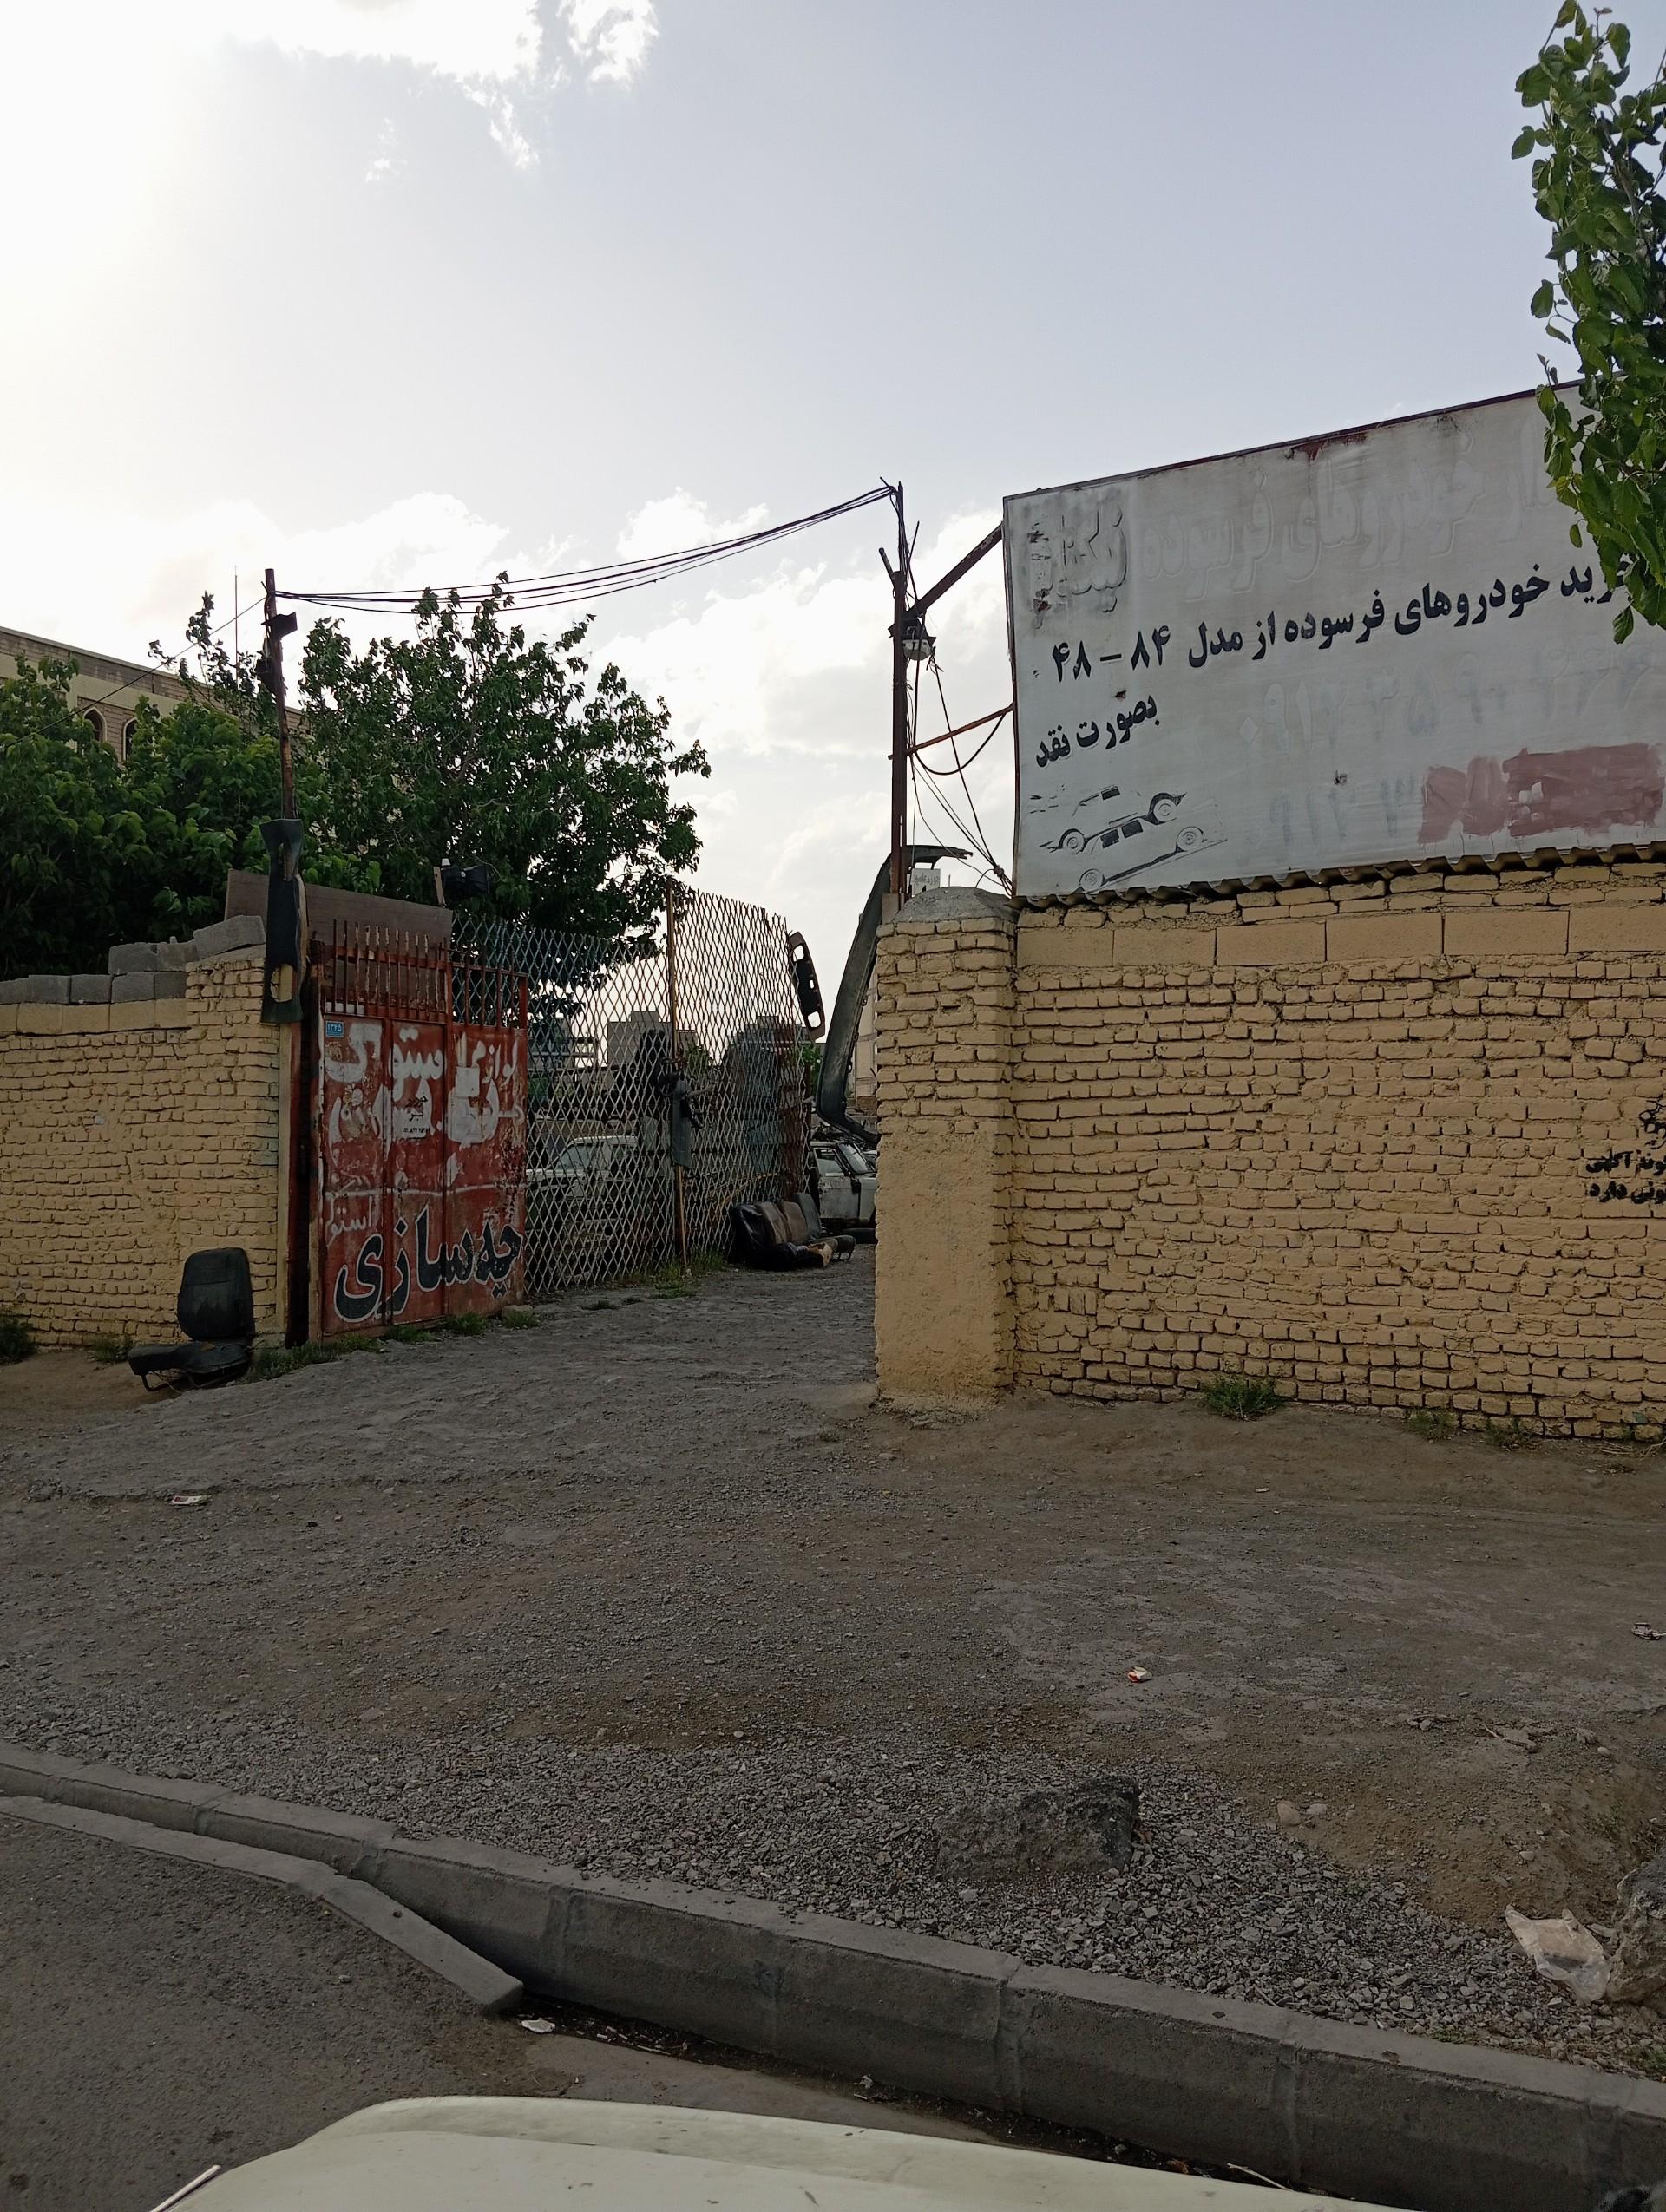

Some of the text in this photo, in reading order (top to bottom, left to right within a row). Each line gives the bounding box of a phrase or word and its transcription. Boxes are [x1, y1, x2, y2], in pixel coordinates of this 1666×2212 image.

[1285, 589, 1385, 650] فرسوده
[1394, 563, 1551, 636] خودروهای
[1188, 621, 1243, 669] مدل
[1251, 610, 1276, 661] از
[1035, 695, 1160, 768] بصورت نقد
